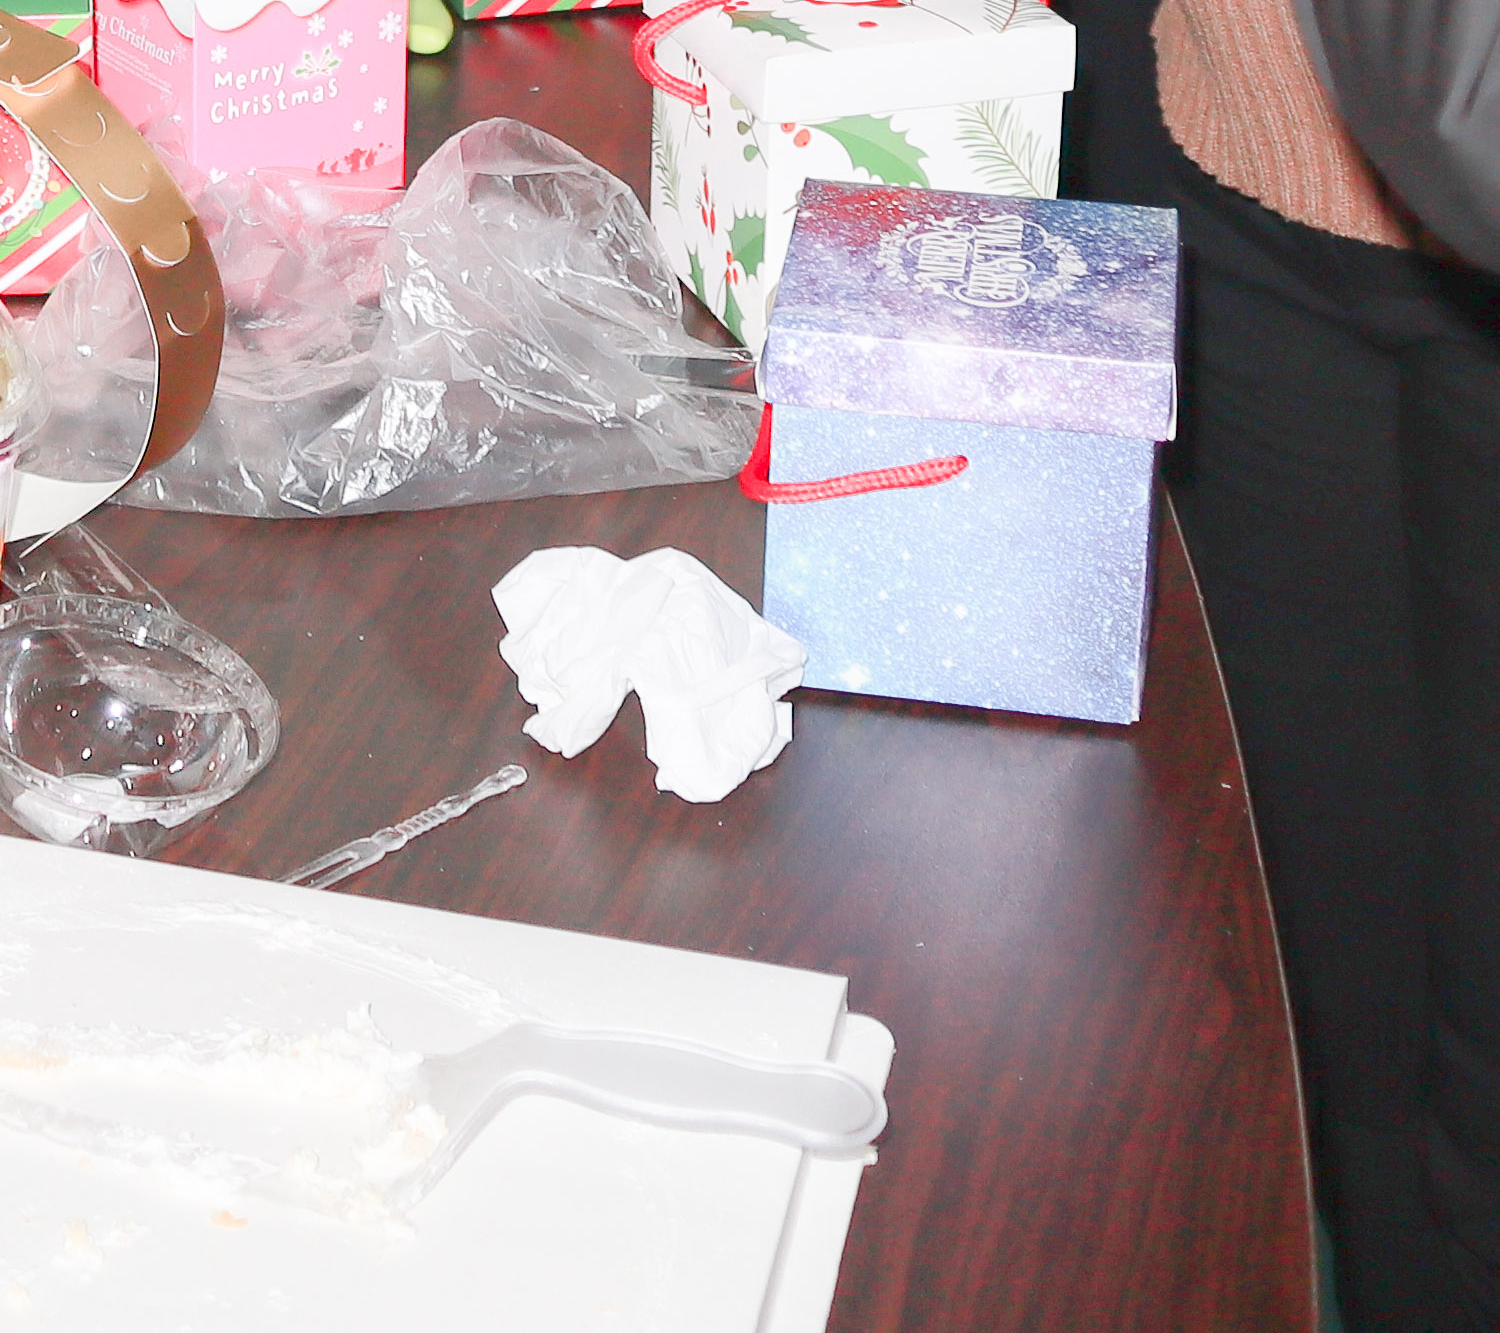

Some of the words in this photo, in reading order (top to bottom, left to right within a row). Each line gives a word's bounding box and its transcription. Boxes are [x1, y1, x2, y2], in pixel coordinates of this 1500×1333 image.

[109, 14, 176, 67] Christmas!
[213, 62, 285, 90] Merry
[209, 77, 339, 124] Christmas
